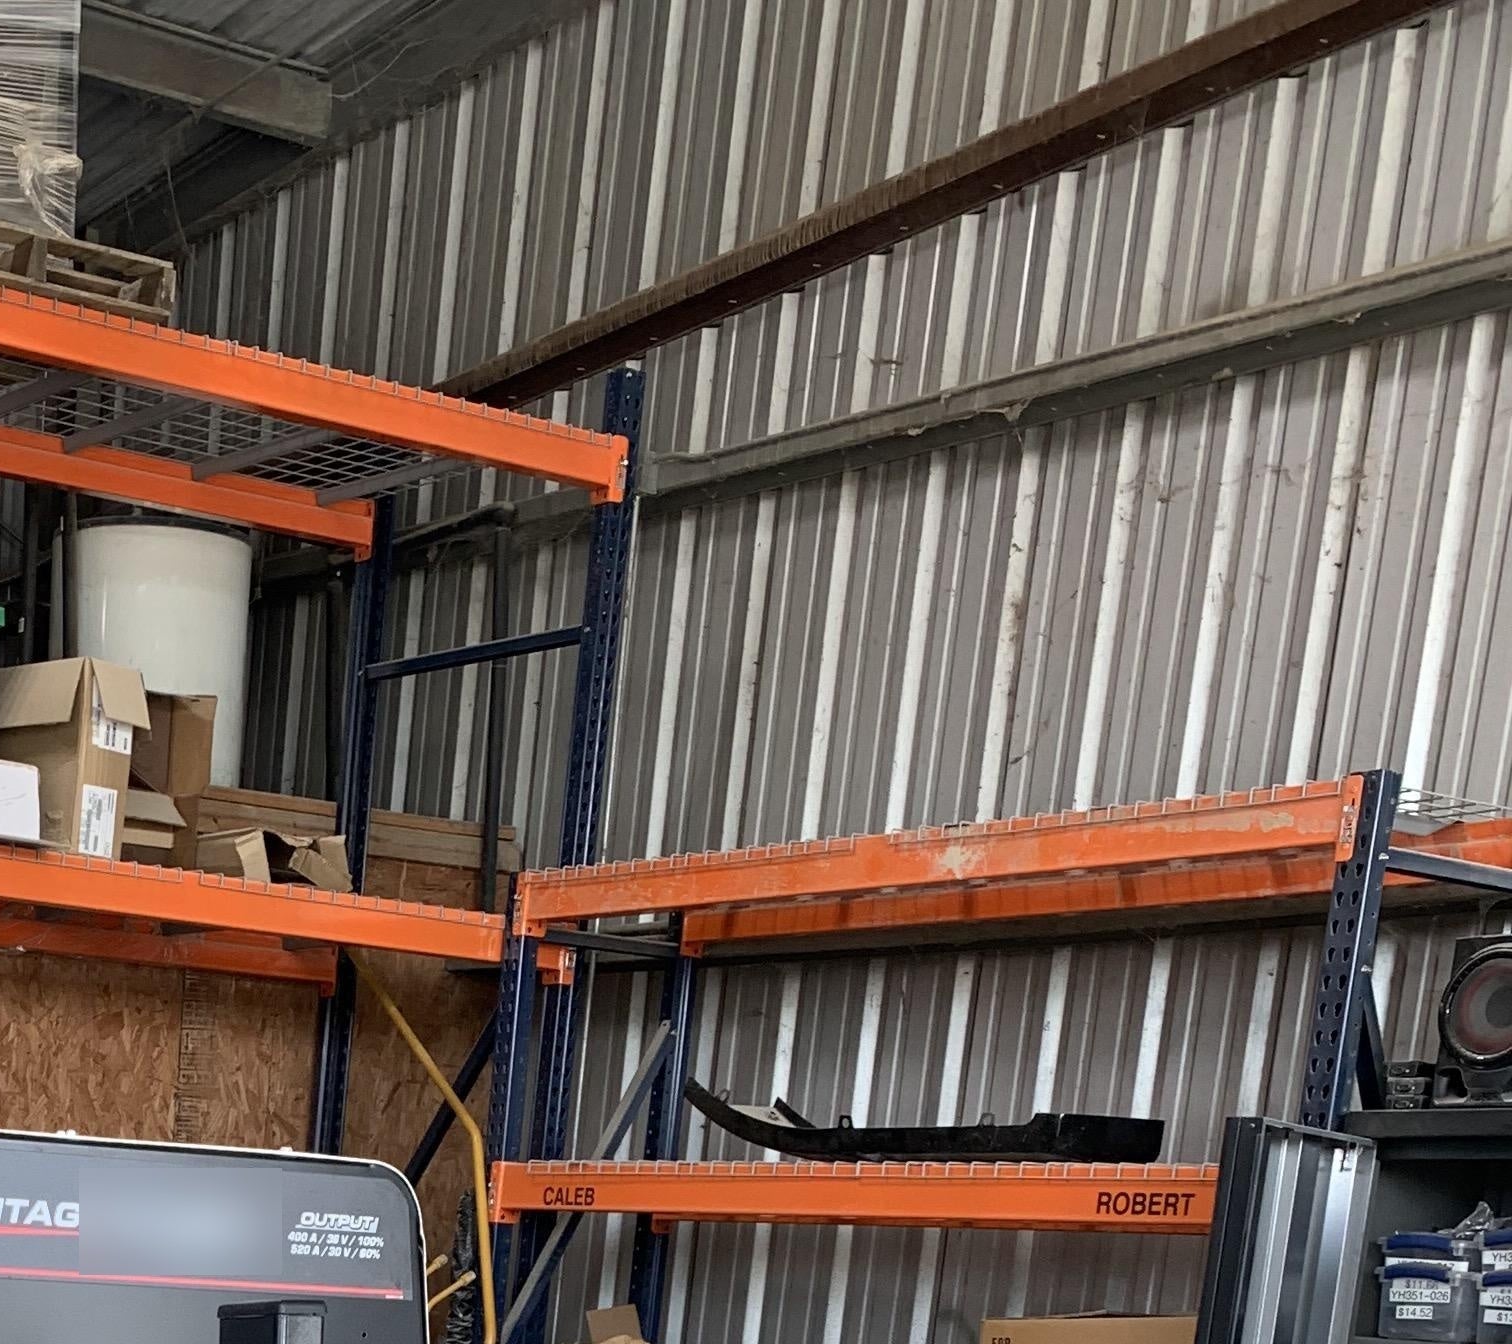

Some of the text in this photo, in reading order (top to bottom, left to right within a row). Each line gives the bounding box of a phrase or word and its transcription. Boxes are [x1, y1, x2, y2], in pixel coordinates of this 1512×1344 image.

[543, 1186, 595, 1206] CALEB
[1096, 1191, 1196, 1216] ROBERT
[300, 1211, 374, 1230] OUTPUT
[358, 1236, 385, 1248] 100%
[1391, 1290, 1449, 1301] YH351-026
